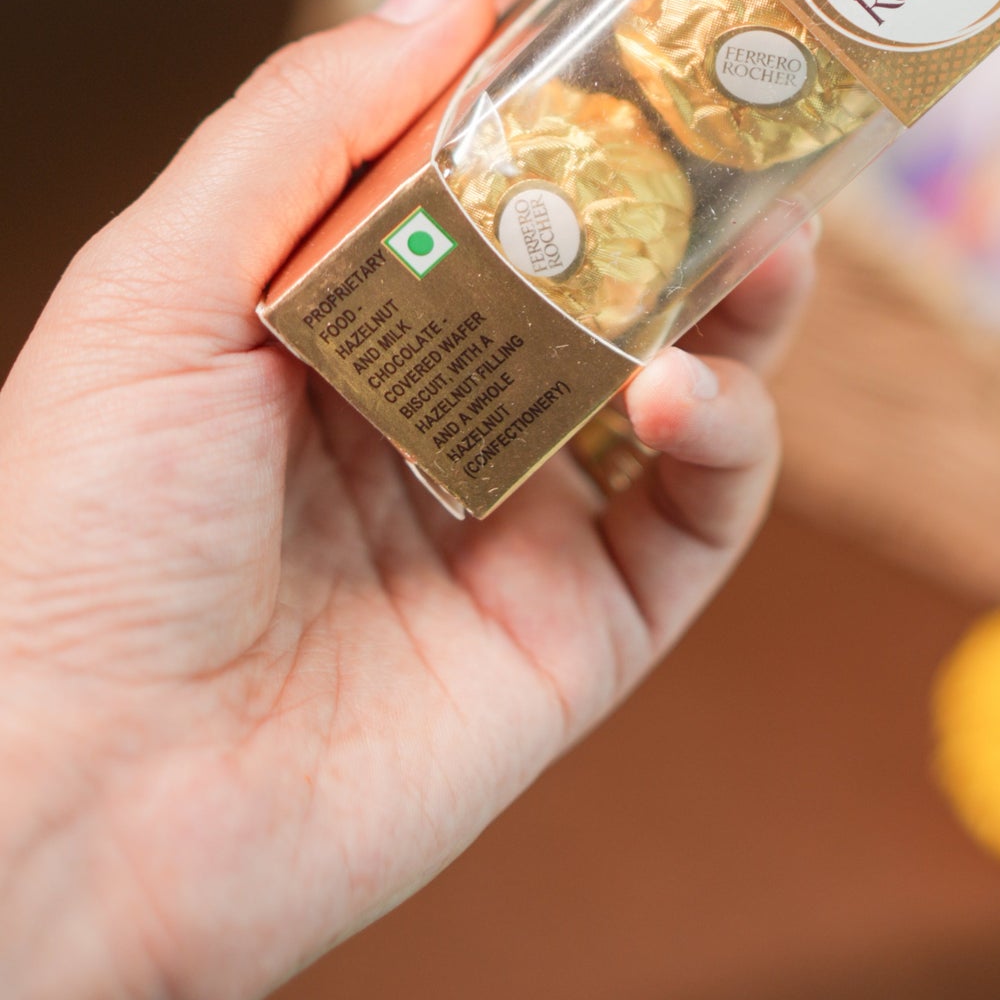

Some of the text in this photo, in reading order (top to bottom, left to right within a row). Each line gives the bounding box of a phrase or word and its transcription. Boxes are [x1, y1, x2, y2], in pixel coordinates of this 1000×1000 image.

[722, 61, 798, 87] ROCHER
[724, 46, 802, 73] FERRERO
[514, 199, 548, 273] FERRERO
[530, 193, 563, 269] ROCHER
[302, 249, 387, 330] PROPRIETARY
[335, 298, 399, 360] HAZELNUT
[353, 320, 412, 375] AND MILK
[384, 311, 487, 404] COVERED WAFER
[447, 343, 483, 375] WITH
[480, 335, 494, 349] A
[415, 335, 524, 434] HAZELNUT FILLING
[432, 372, 515, 449] AND A WHOLE
[446, 403, 510, 463] HAZELNUT
[463, 380, 571, 479] (CONFECTIONERY)
